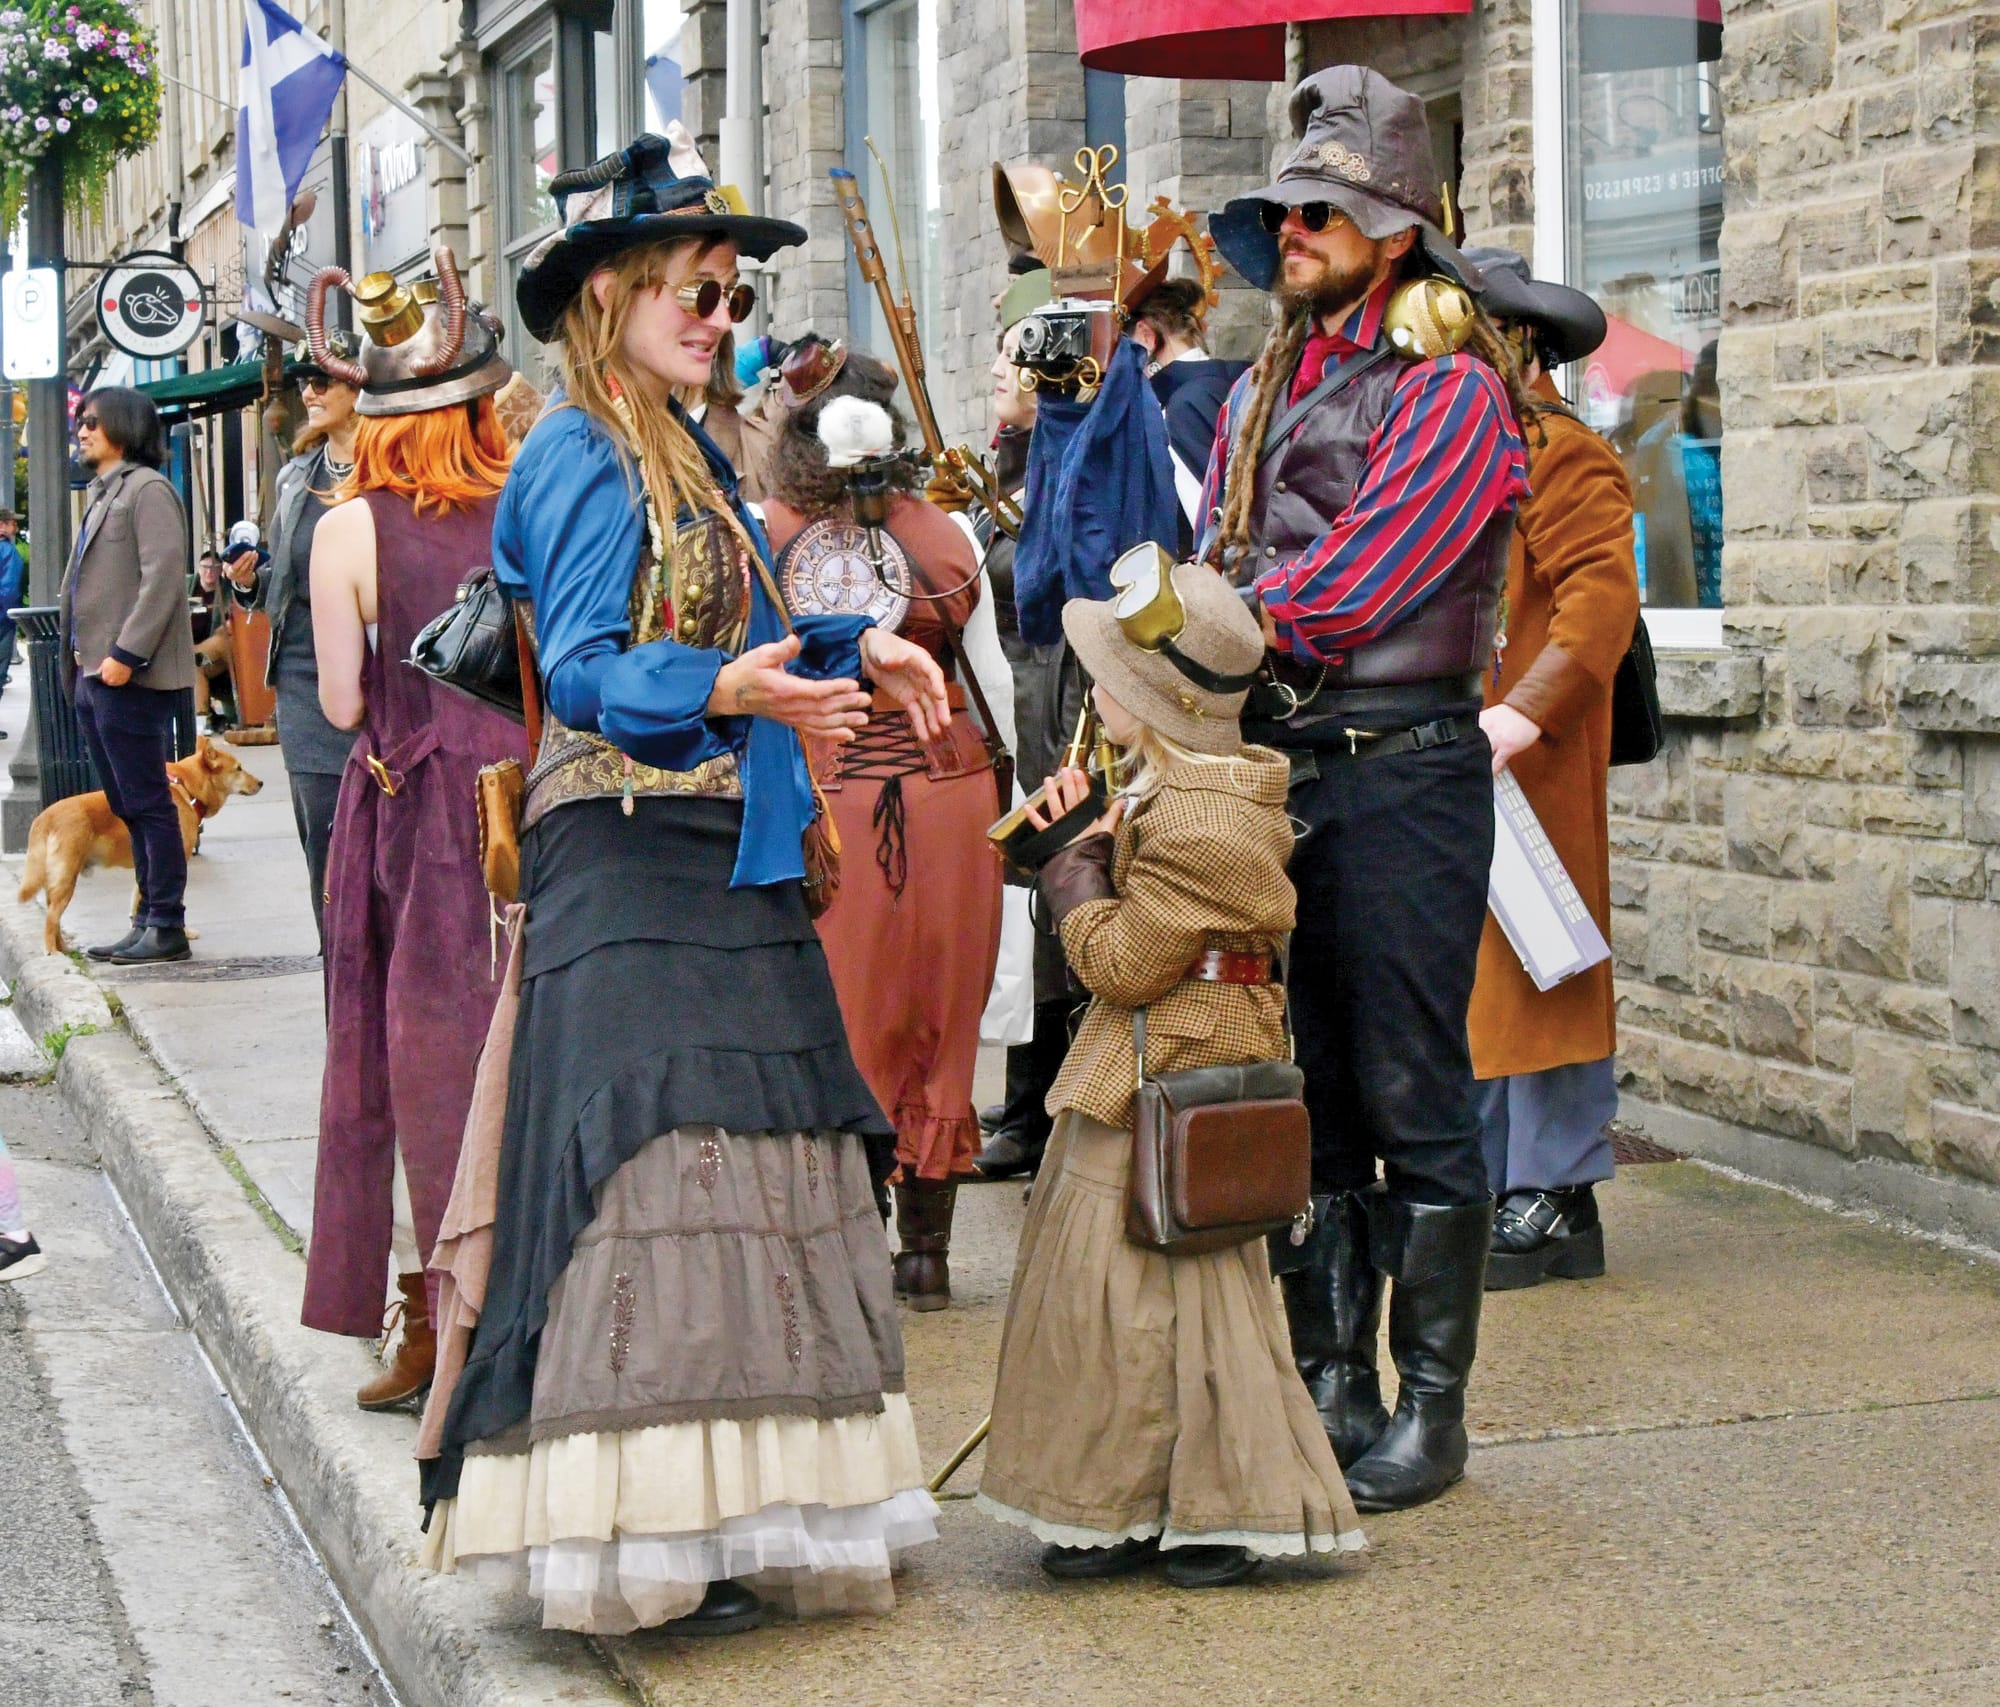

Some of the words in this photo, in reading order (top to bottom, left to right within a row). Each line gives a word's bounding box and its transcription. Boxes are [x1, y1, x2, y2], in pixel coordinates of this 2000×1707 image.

[24, 289, 40, 313] P
[818, 532, 835, 553] 8
[843, 529, 856, 549] 9
